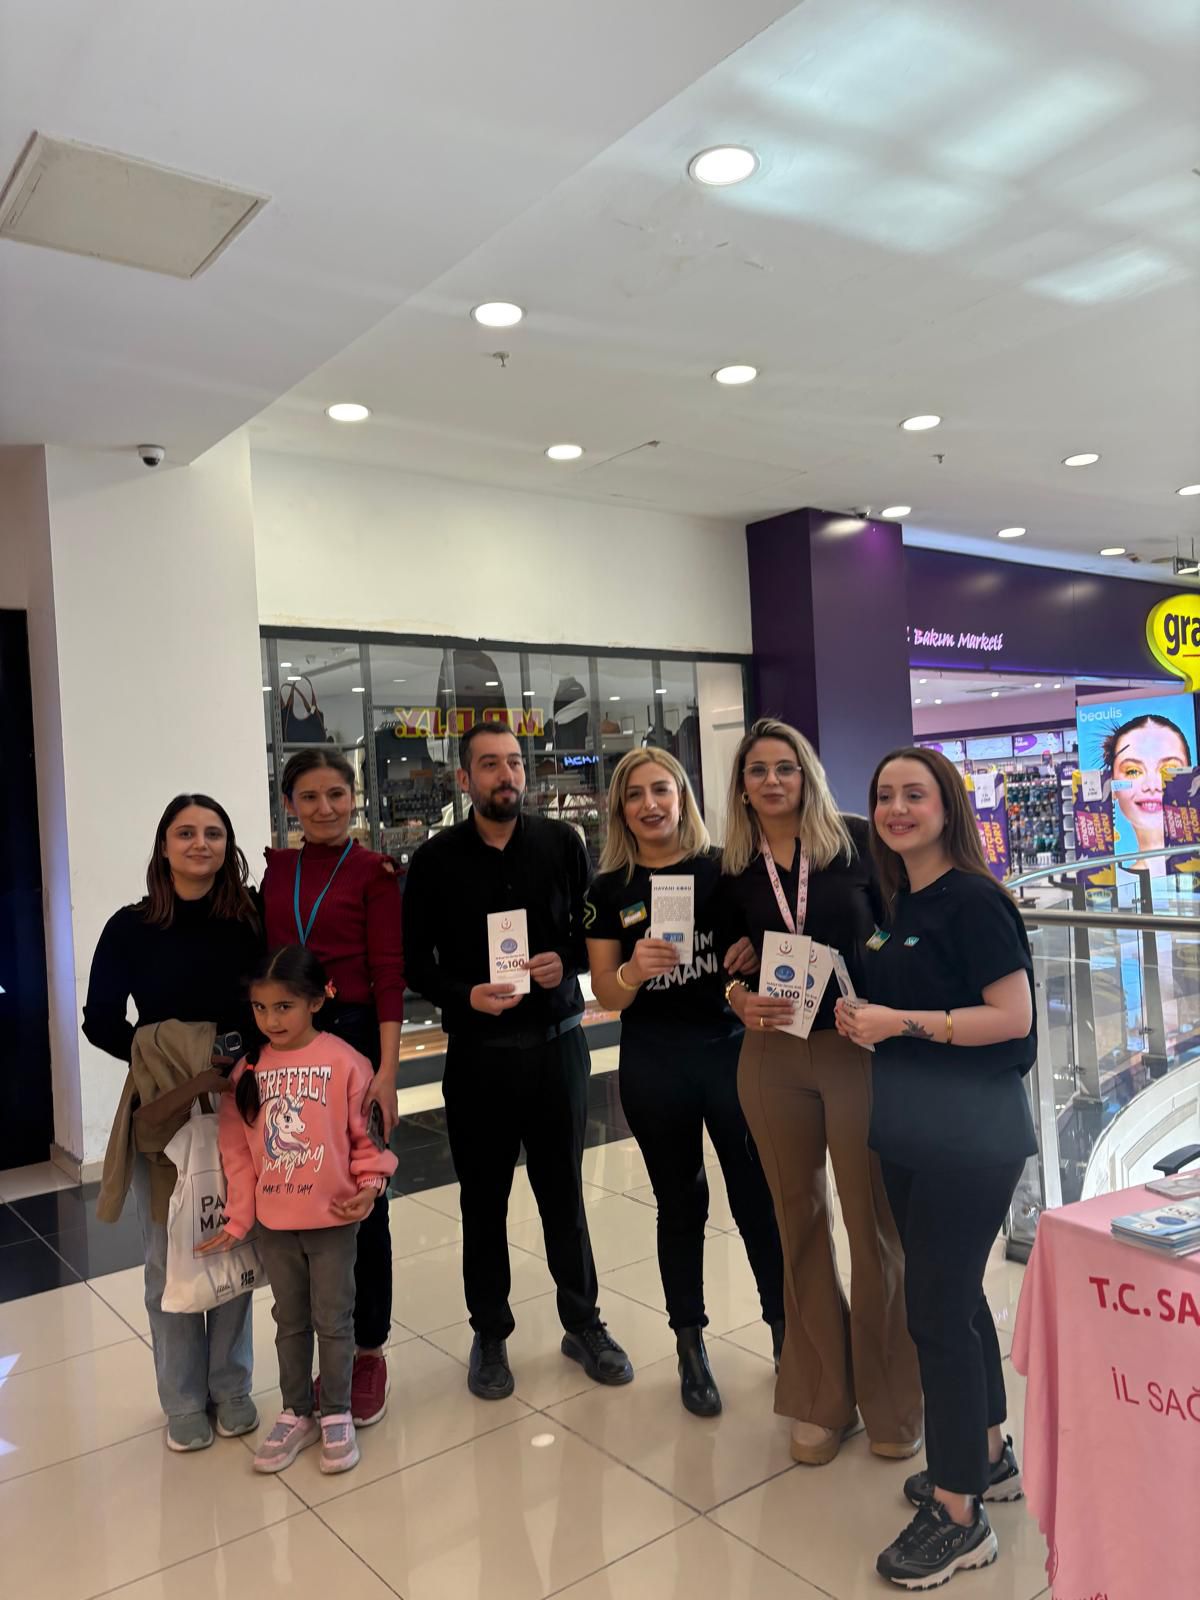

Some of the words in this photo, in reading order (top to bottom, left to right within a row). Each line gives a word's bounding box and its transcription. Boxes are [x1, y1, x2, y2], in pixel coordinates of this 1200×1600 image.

[1080, 706, 1122, 722] beaulis
[766, 986, 801, 999] %100
[255, 1066, 332, 1107] ERFFECT
[1089, 1276, 1151, 1317] T.C.
[1112, 1367, 1140, 1405] İL
